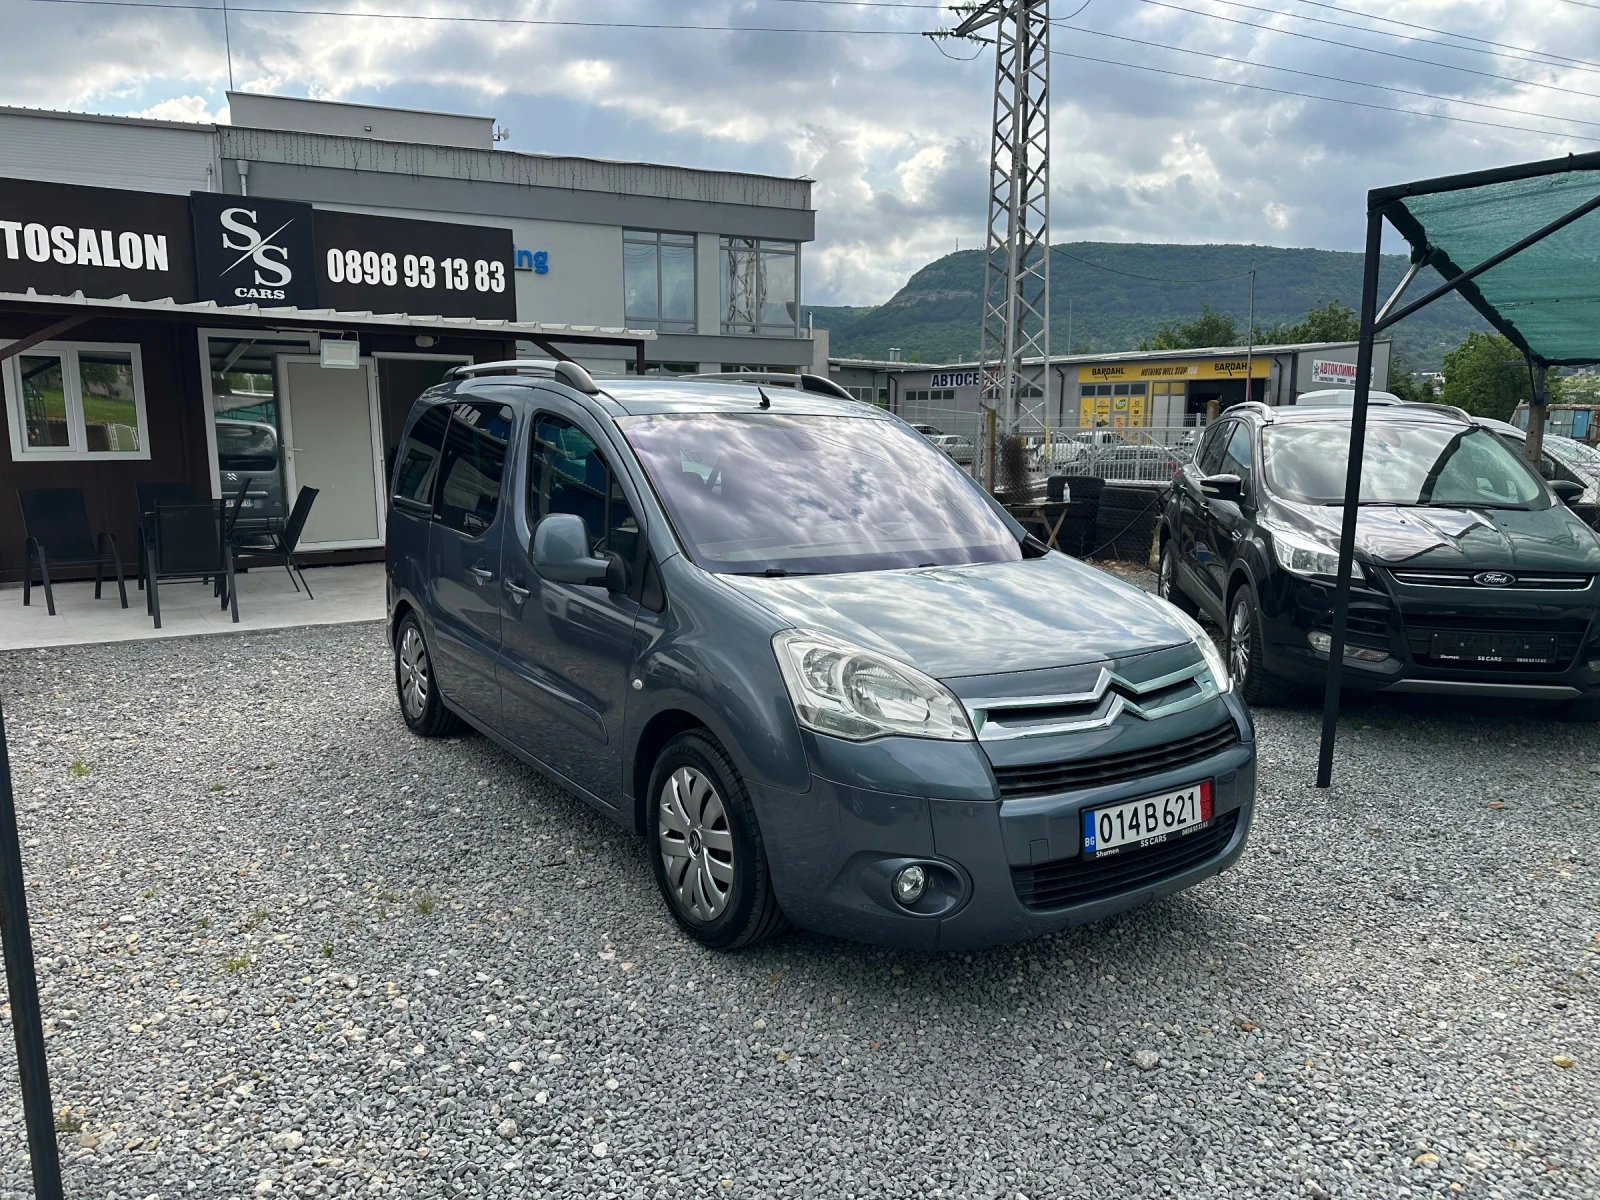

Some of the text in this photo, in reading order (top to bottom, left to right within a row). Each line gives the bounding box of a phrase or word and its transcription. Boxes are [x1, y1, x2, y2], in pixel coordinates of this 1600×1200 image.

[327, 248, 506, 292] 0898 93 13 83
[234, 288, 286, 300] CARS
[1092, 367, 1126, 380] BARDAHL
[1174, 366, 1188, 375] STOP
[1484, 574, 1507, 583] Ford
[1100, 792, 1195, 843] 014B621
[1085, 836, 1095, 847] BG
[1096, 848, 1120, 858] Shumen
[1140, 839, 1148, 848] SS
[1149, 834, 1166, 845] CARS
